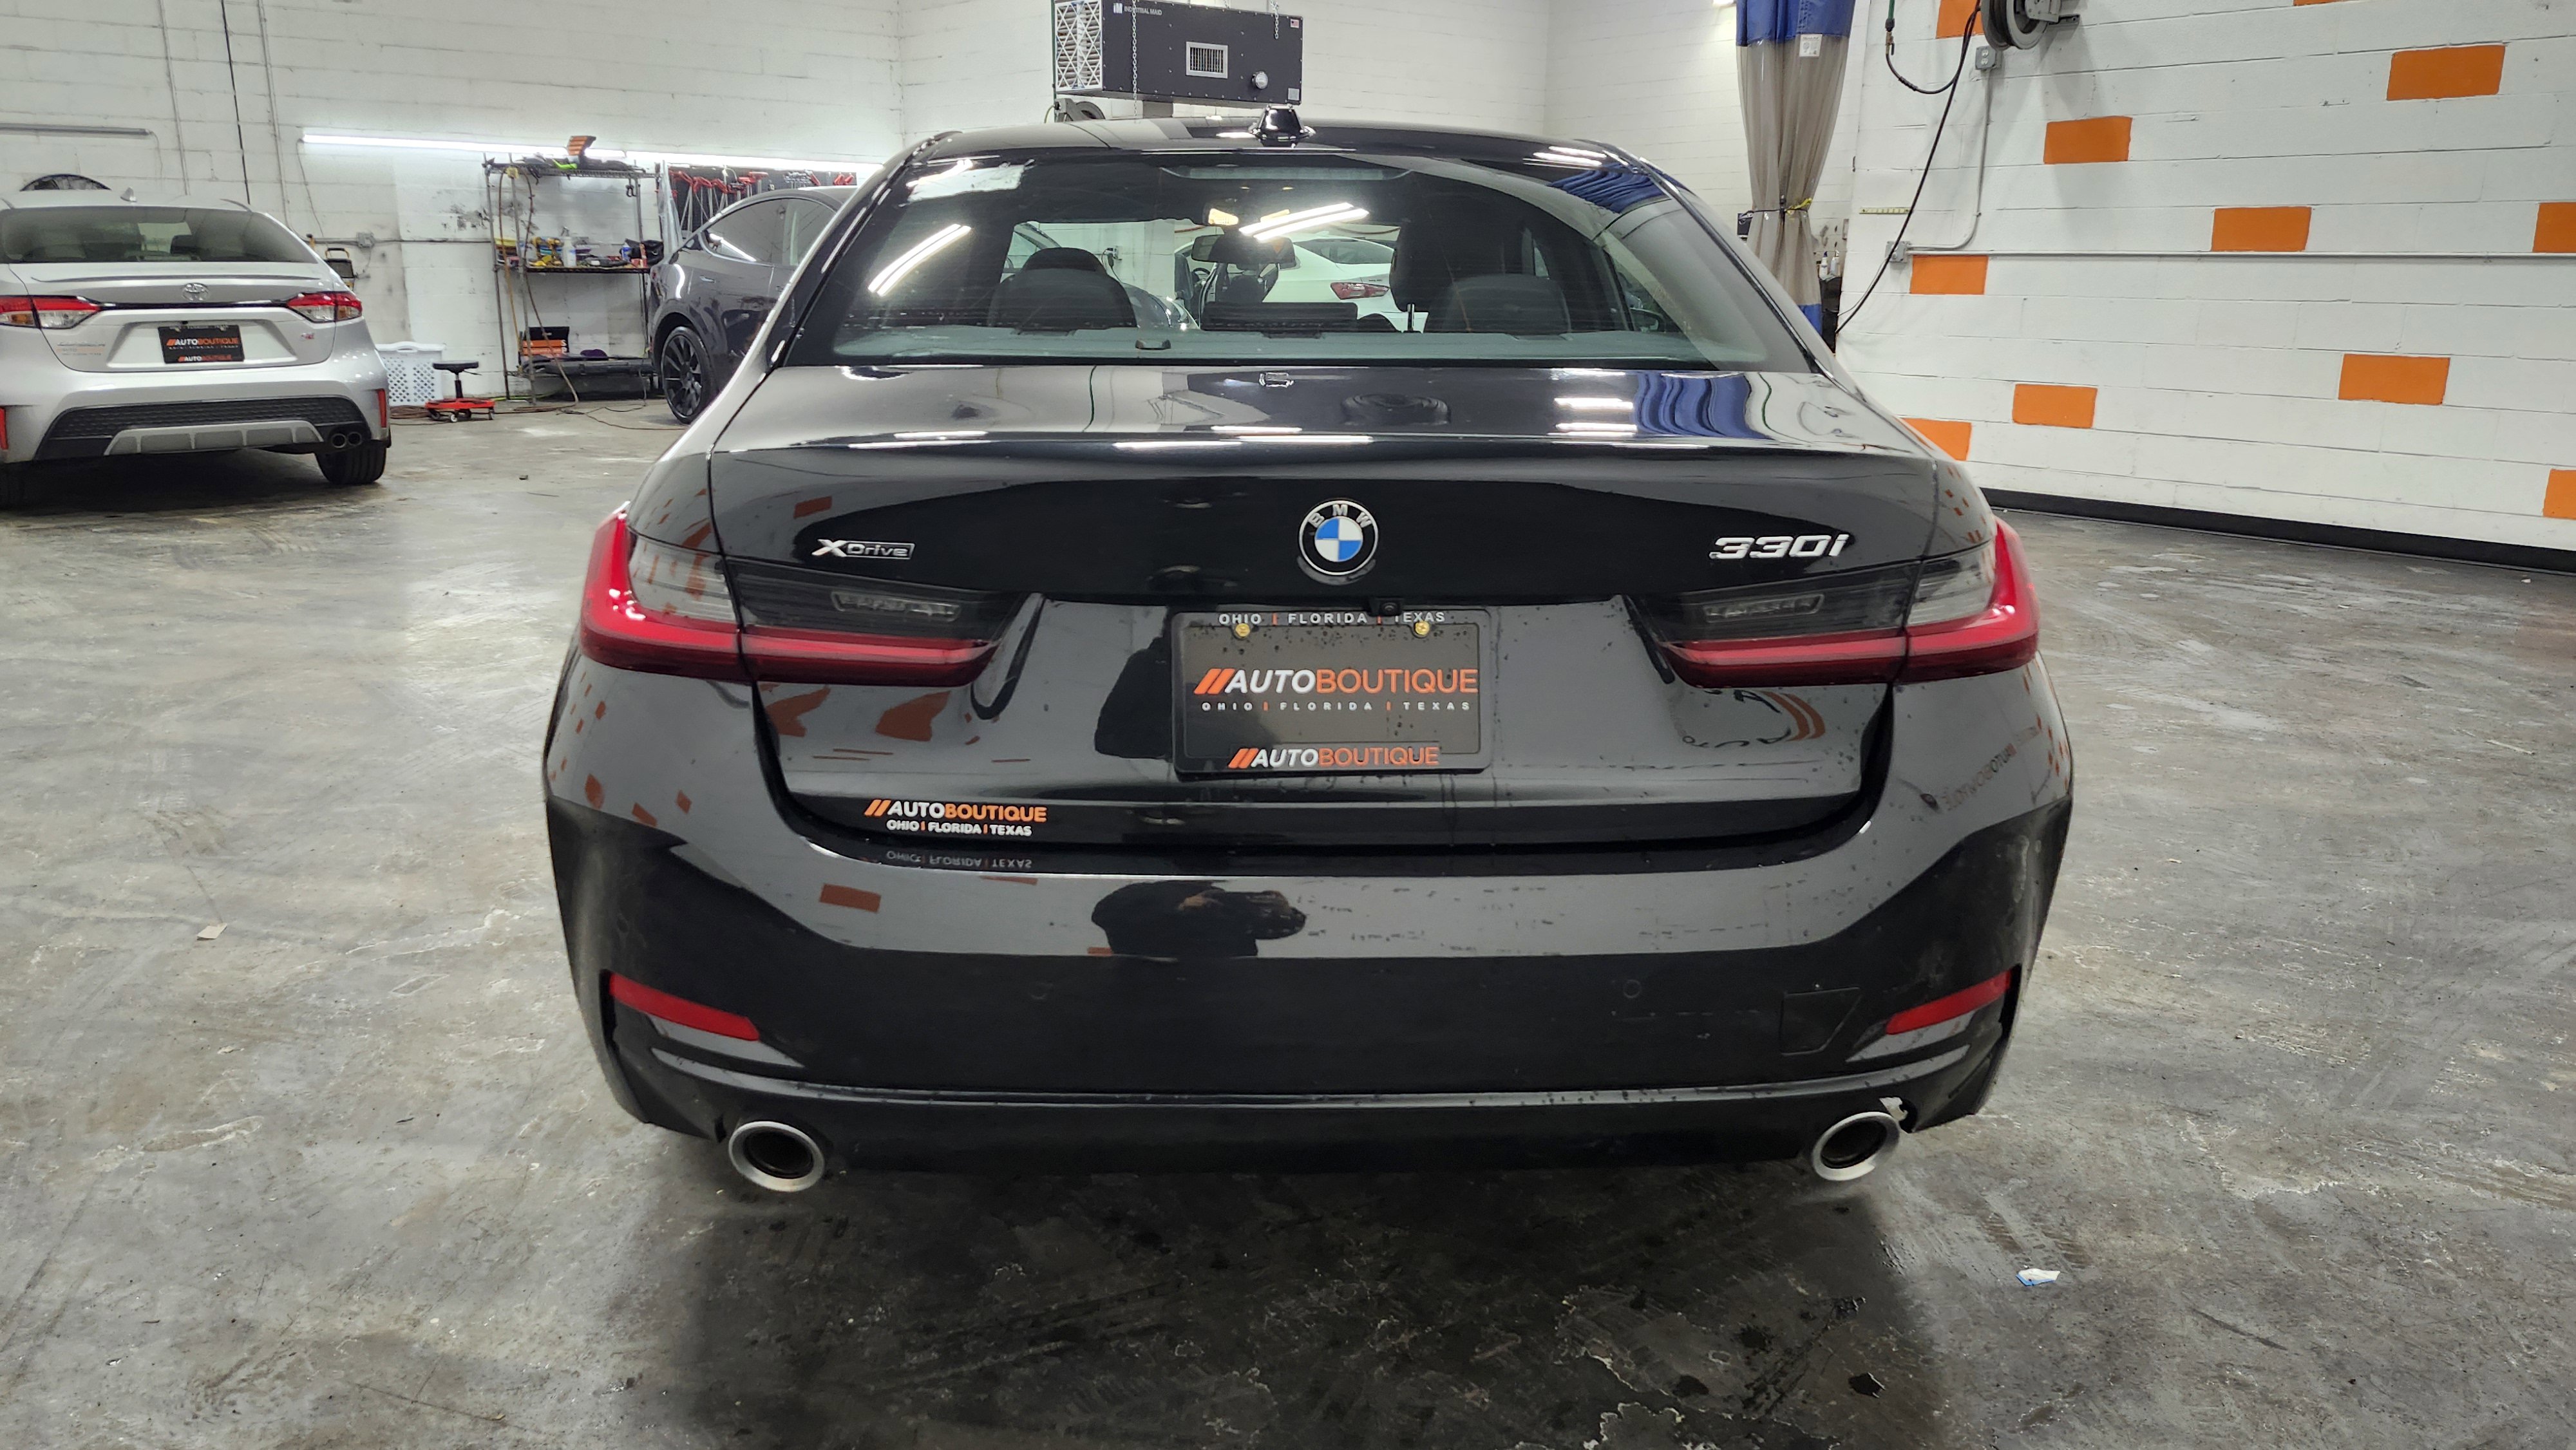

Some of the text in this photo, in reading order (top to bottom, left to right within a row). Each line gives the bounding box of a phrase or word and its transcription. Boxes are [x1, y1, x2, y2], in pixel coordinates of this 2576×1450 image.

[1124, 6, 1150, 14] INDSTRIAL
[1308, 504, 1372, 528] BMW
[1709, 534, 1850, 560] 330i
[1218, 613, 1262, 625] OHIO
[1287, 613, 1368, 624] FLORIDA
[1224, 668, 1479, 694] AUTOBOUTIQUE
[1202, 701, 1470, 711] OHIO FLORIDA TEXAS
[1251, 746, 1440, 768] AUTOBOUTIQUE
[886, 800, 1048, 823] AUTOBOUTIQUE
[886, 819, 1032, 837] OHIO FLORIDA TEXAS
